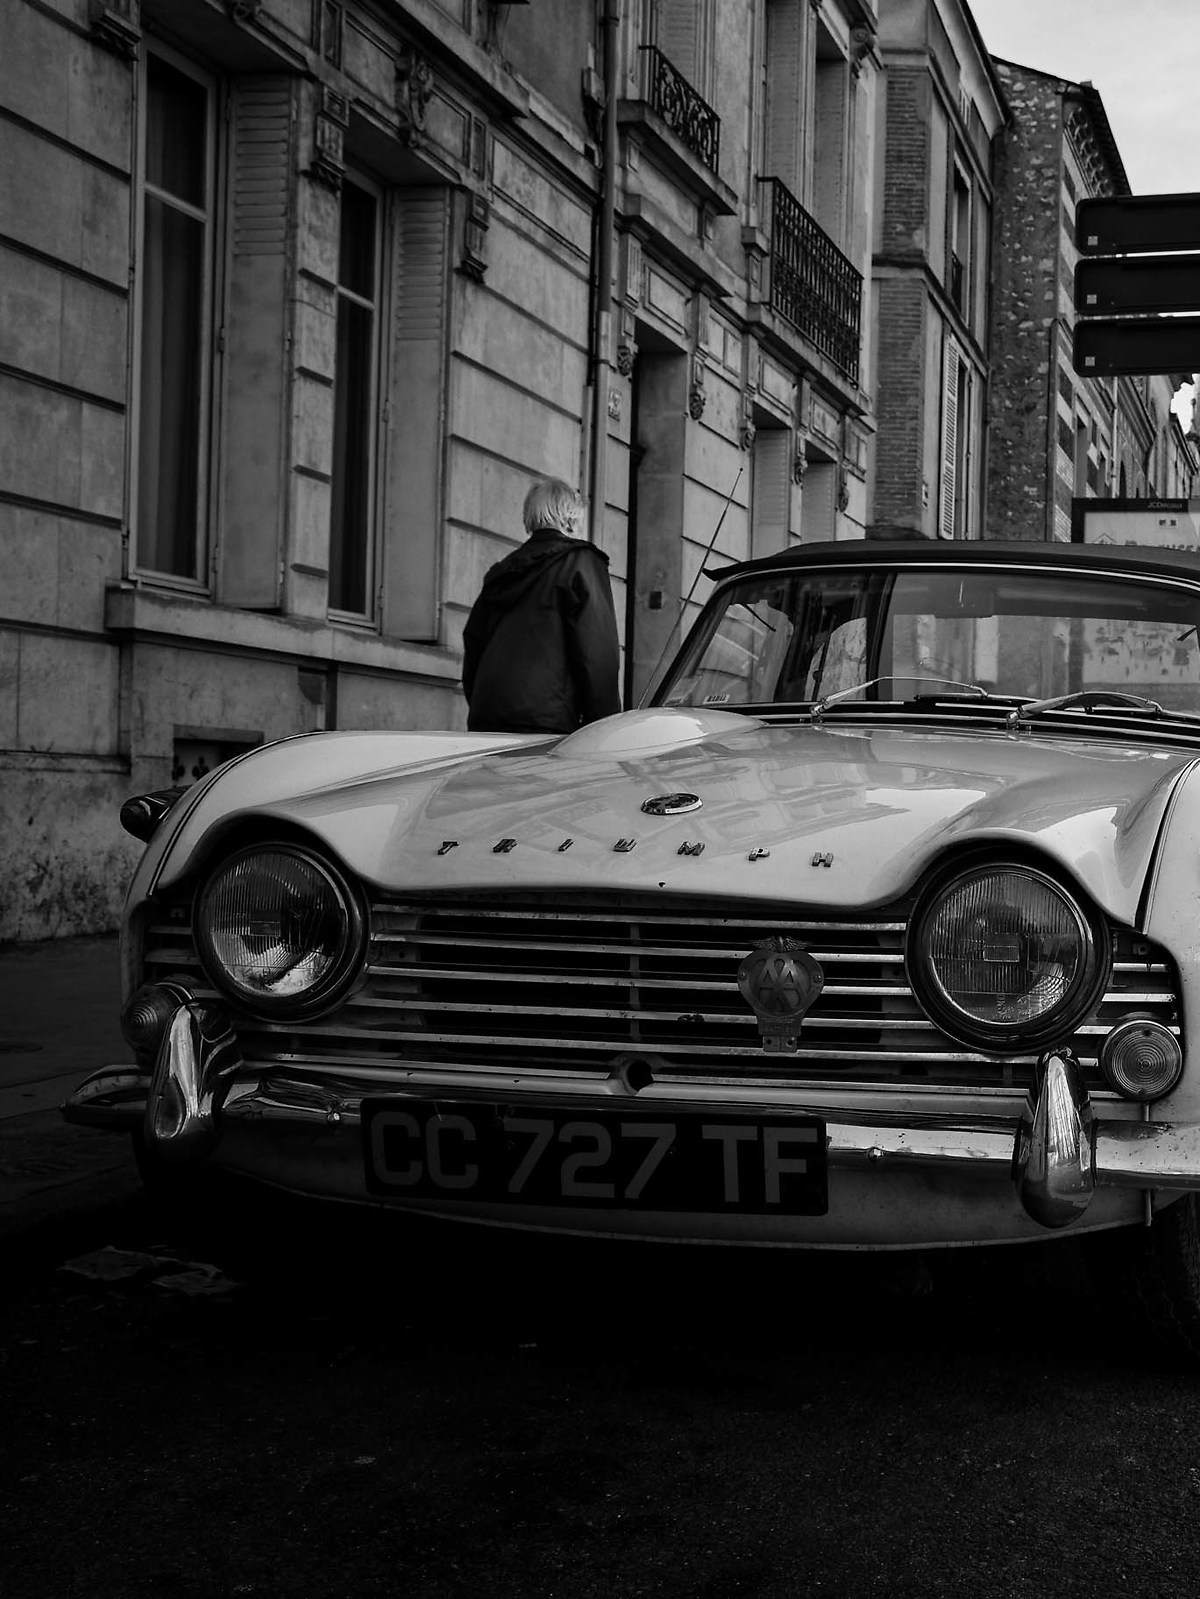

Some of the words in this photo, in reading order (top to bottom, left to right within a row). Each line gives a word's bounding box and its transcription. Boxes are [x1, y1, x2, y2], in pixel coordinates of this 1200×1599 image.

[437, 838, 834, 868] TRIUMPH
[370, 1111, 479, 1189] CC
[502, 1116, 677, 1200] 727
[702, 1123, 819, 1204] TF
